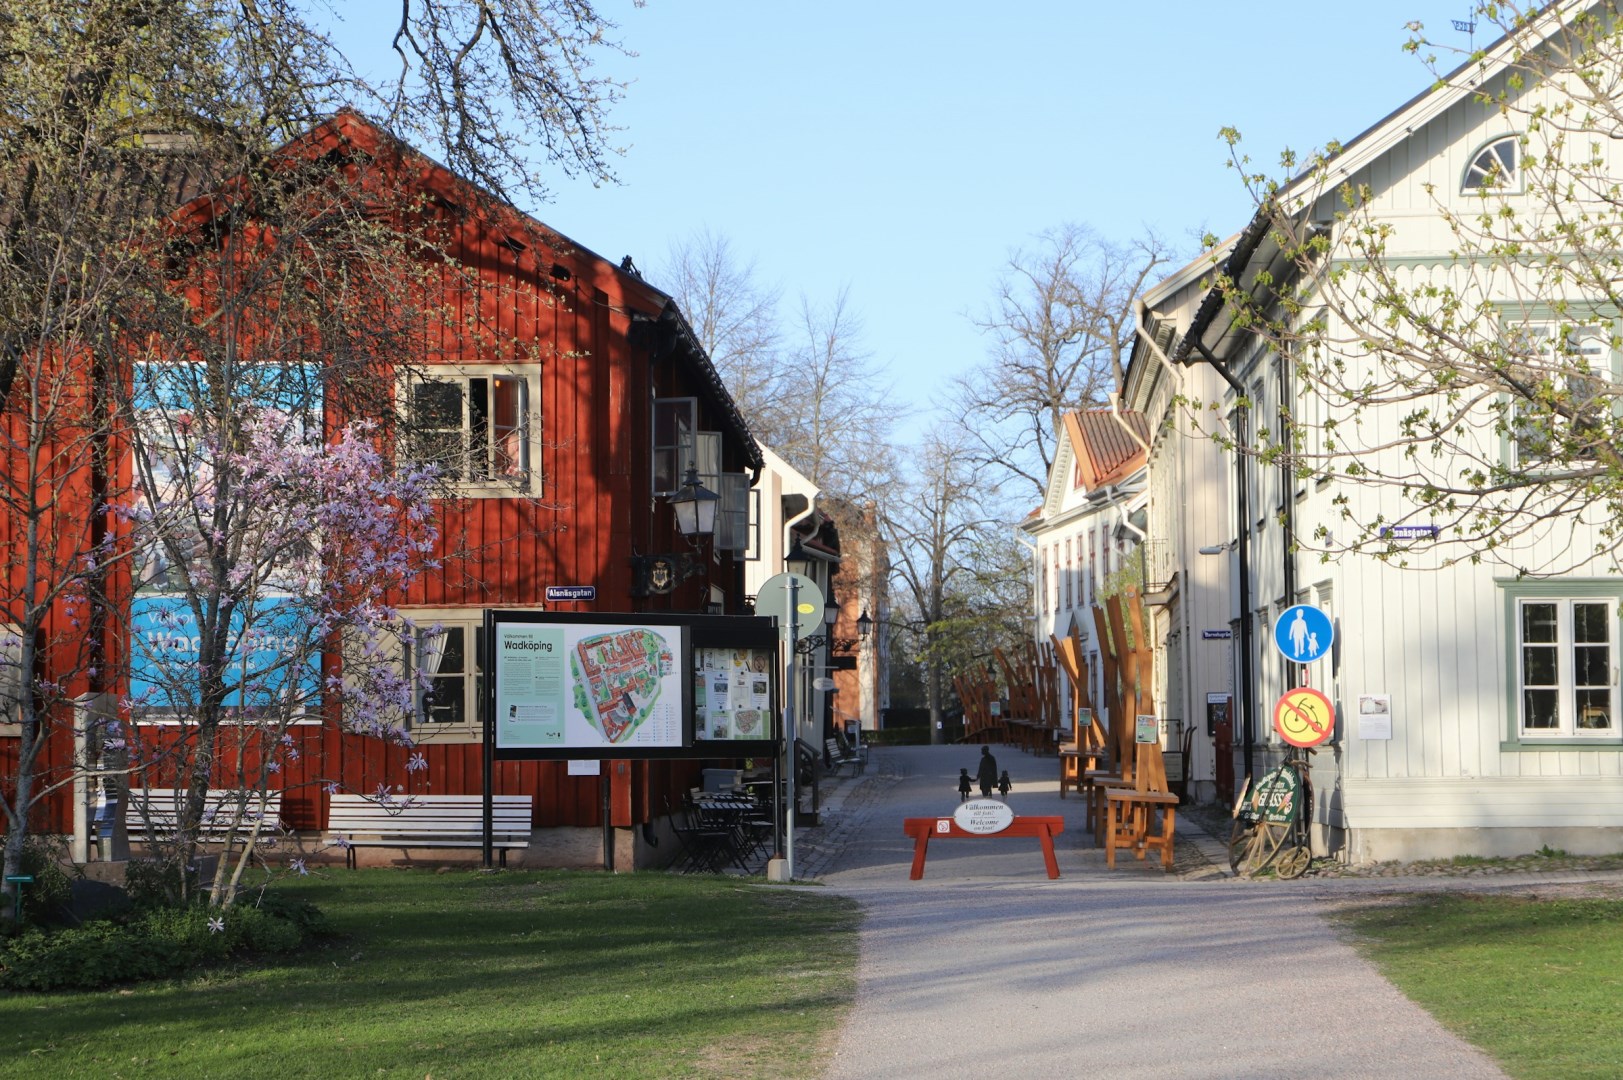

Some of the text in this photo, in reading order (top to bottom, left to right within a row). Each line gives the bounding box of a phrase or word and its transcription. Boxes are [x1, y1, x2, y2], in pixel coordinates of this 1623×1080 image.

[1388, 528, 1433, 539] lsnäsgatan
[549, 589, 592, 599] Alsnäsgatan
[148, 631, 298, 657] Waöping
[504, 640, 552, 652] Wadköping
